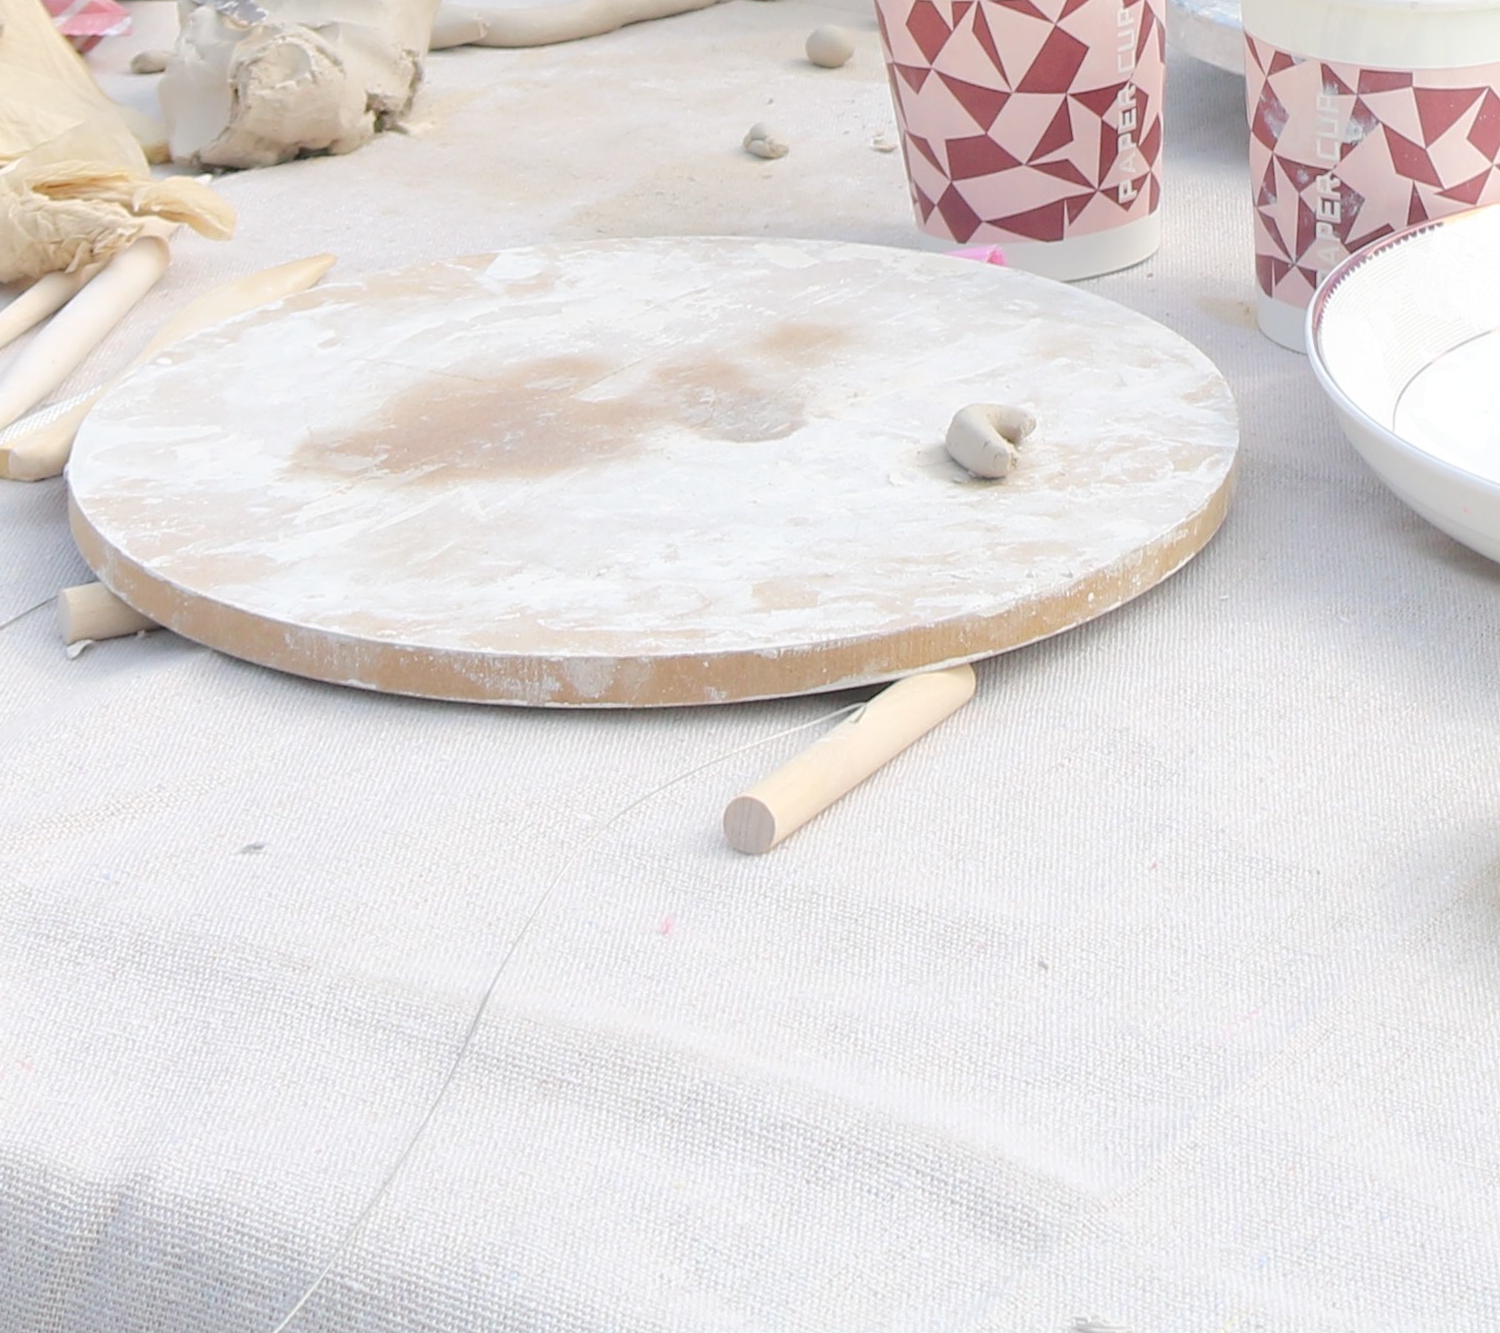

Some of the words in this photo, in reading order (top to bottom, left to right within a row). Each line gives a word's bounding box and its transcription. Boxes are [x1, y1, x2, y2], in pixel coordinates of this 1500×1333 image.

[1117, 6, 1138, 75] CUP
[1117, 82, 1138, 204] PAPER
[1315, 88, 1342, 162] CUP
